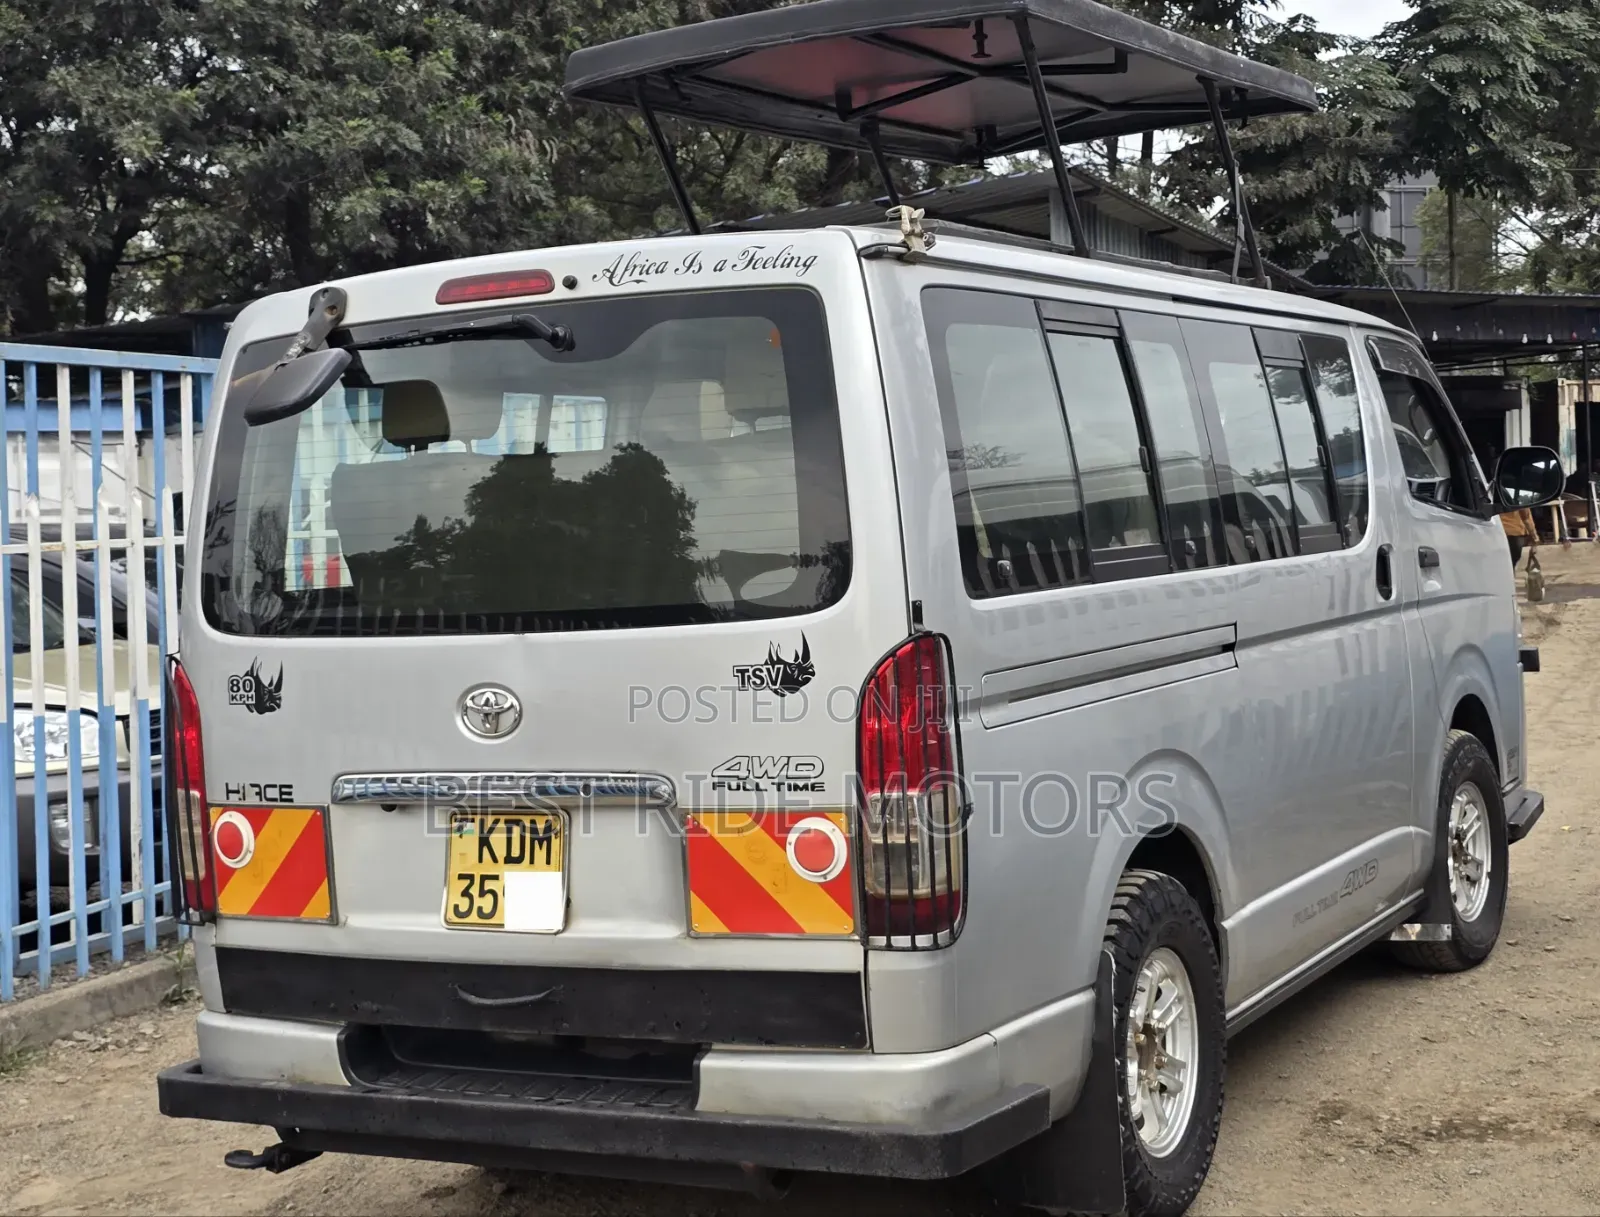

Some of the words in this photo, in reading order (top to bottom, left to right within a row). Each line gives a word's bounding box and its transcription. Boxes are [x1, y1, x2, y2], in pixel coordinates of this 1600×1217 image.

[592, 251, 669, 287] Africa
[674, 250, 703, 275] Is
[712, 258, 728, 273] a
[732, 244, 819, 278] Feeling
[229, 677, 254, 694] 80
[734, 665, 783, 691] TSV
[230, 693, 254, 702] KPH
[711, 755, 825, 781] 4WD
[712, 781, 768, 792] FULL
[771, 781, 826, 792] TIME
[477, 818, 553, 866] KDM
[1340, 857, 1379, 899] 4WD
[453, 873, 505, 920] 35
